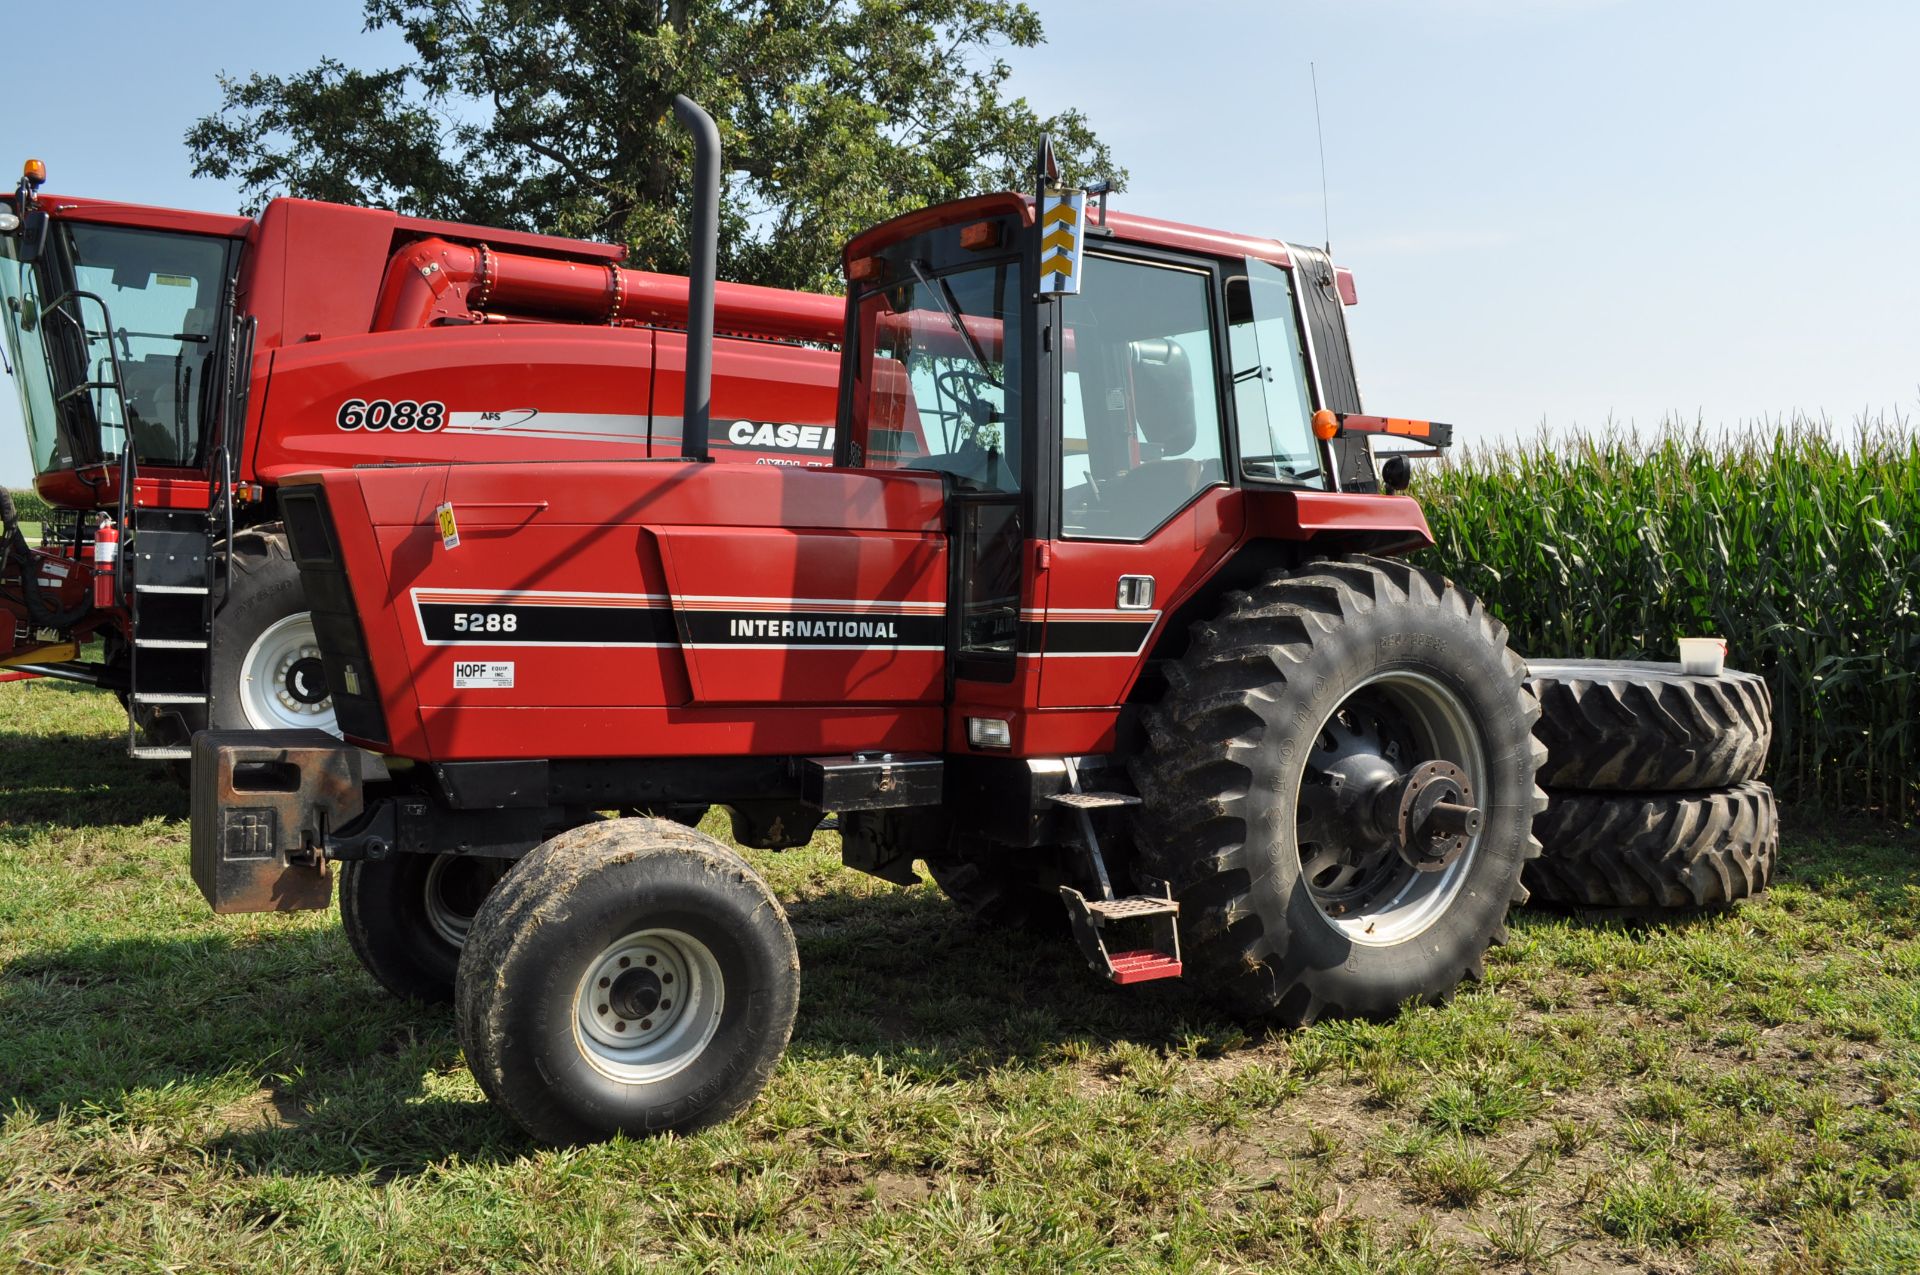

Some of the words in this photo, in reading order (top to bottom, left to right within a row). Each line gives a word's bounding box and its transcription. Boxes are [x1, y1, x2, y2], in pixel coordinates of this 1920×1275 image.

[337, 398, 445, 432] 6088
[480, 411, 501, 421] AFS
[728, 420, 822, 448] CASE
[453, 613, 518, 632] 5288
[730, 619, 898, 639] INTERNATIONAL
[456, 663, 487, 678] HOPF
